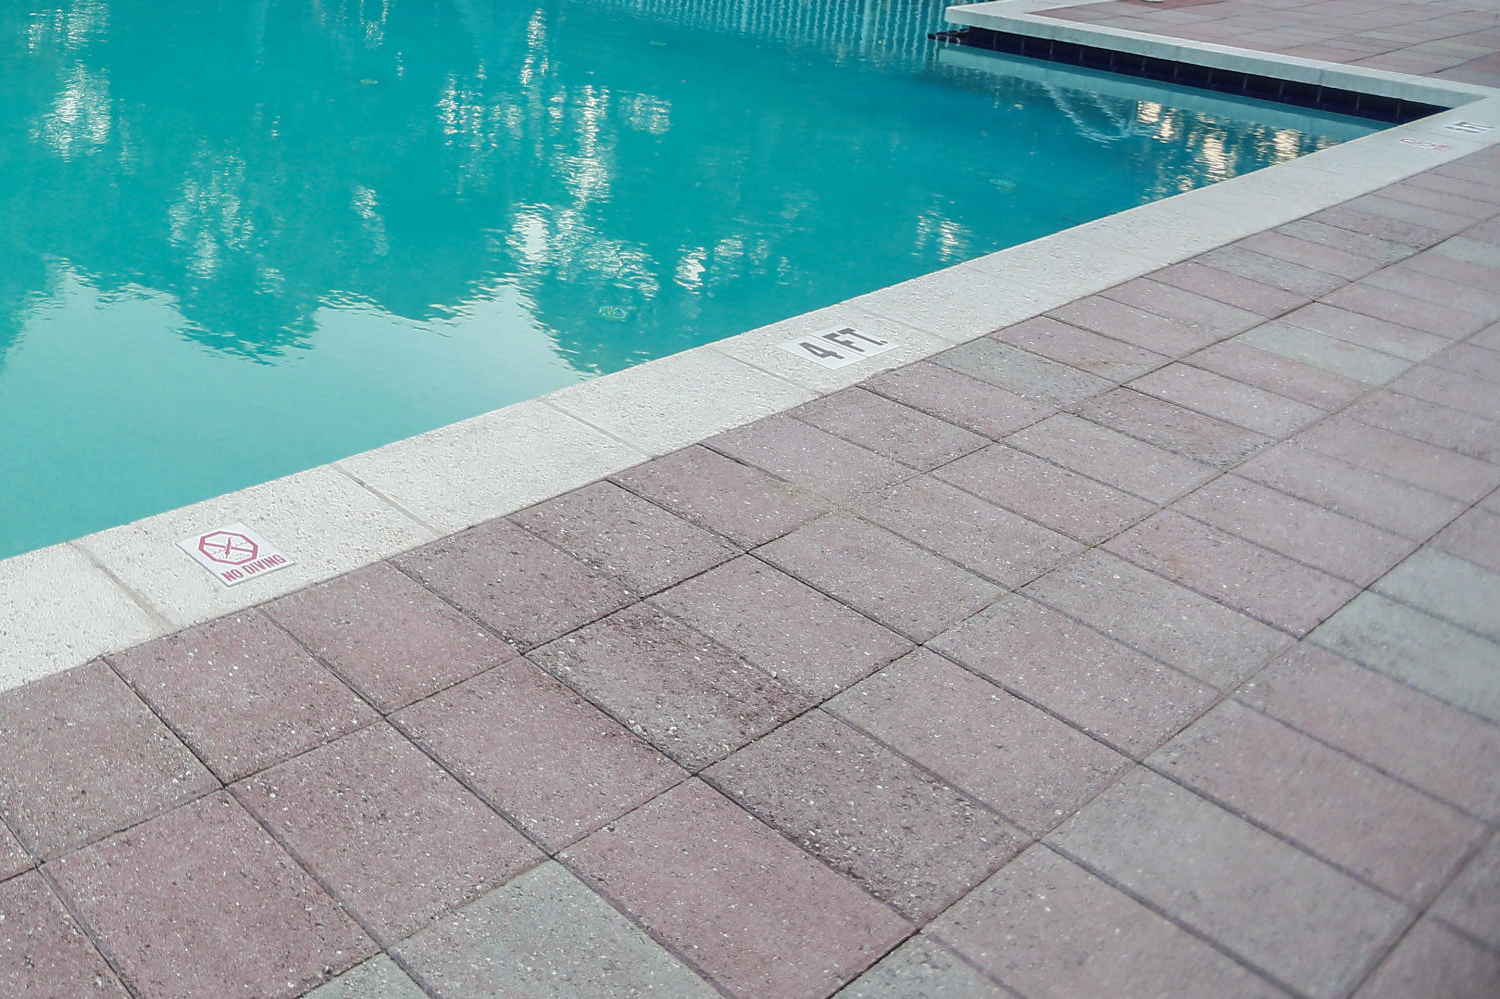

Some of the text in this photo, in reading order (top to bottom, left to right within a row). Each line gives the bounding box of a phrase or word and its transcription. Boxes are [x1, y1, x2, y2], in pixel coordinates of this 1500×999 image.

[798, 341, 846, 360] 4
[221, 554, 287, 582] NO DIVING
